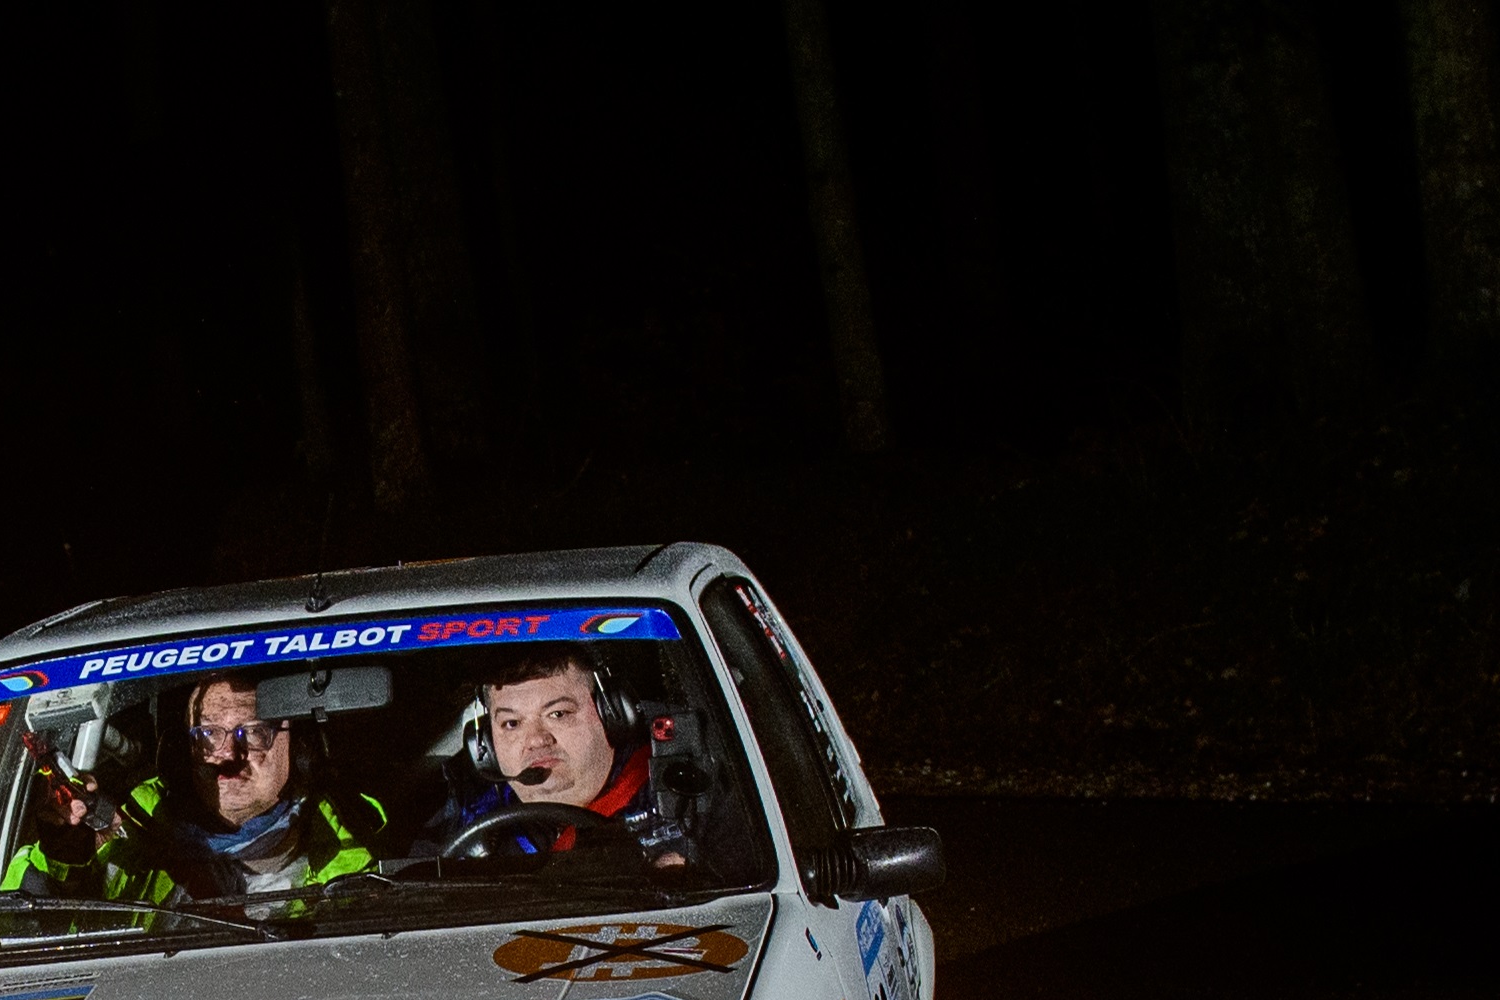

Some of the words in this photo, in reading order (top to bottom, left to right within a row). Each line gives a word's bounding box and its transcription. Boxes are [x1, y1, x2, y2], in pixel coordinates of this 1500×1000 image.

[79, 640, 253, 680] PEUGEOT
[264, 625, 411, 655] TALBOT
[417, 615, 550, 641] SPORT
